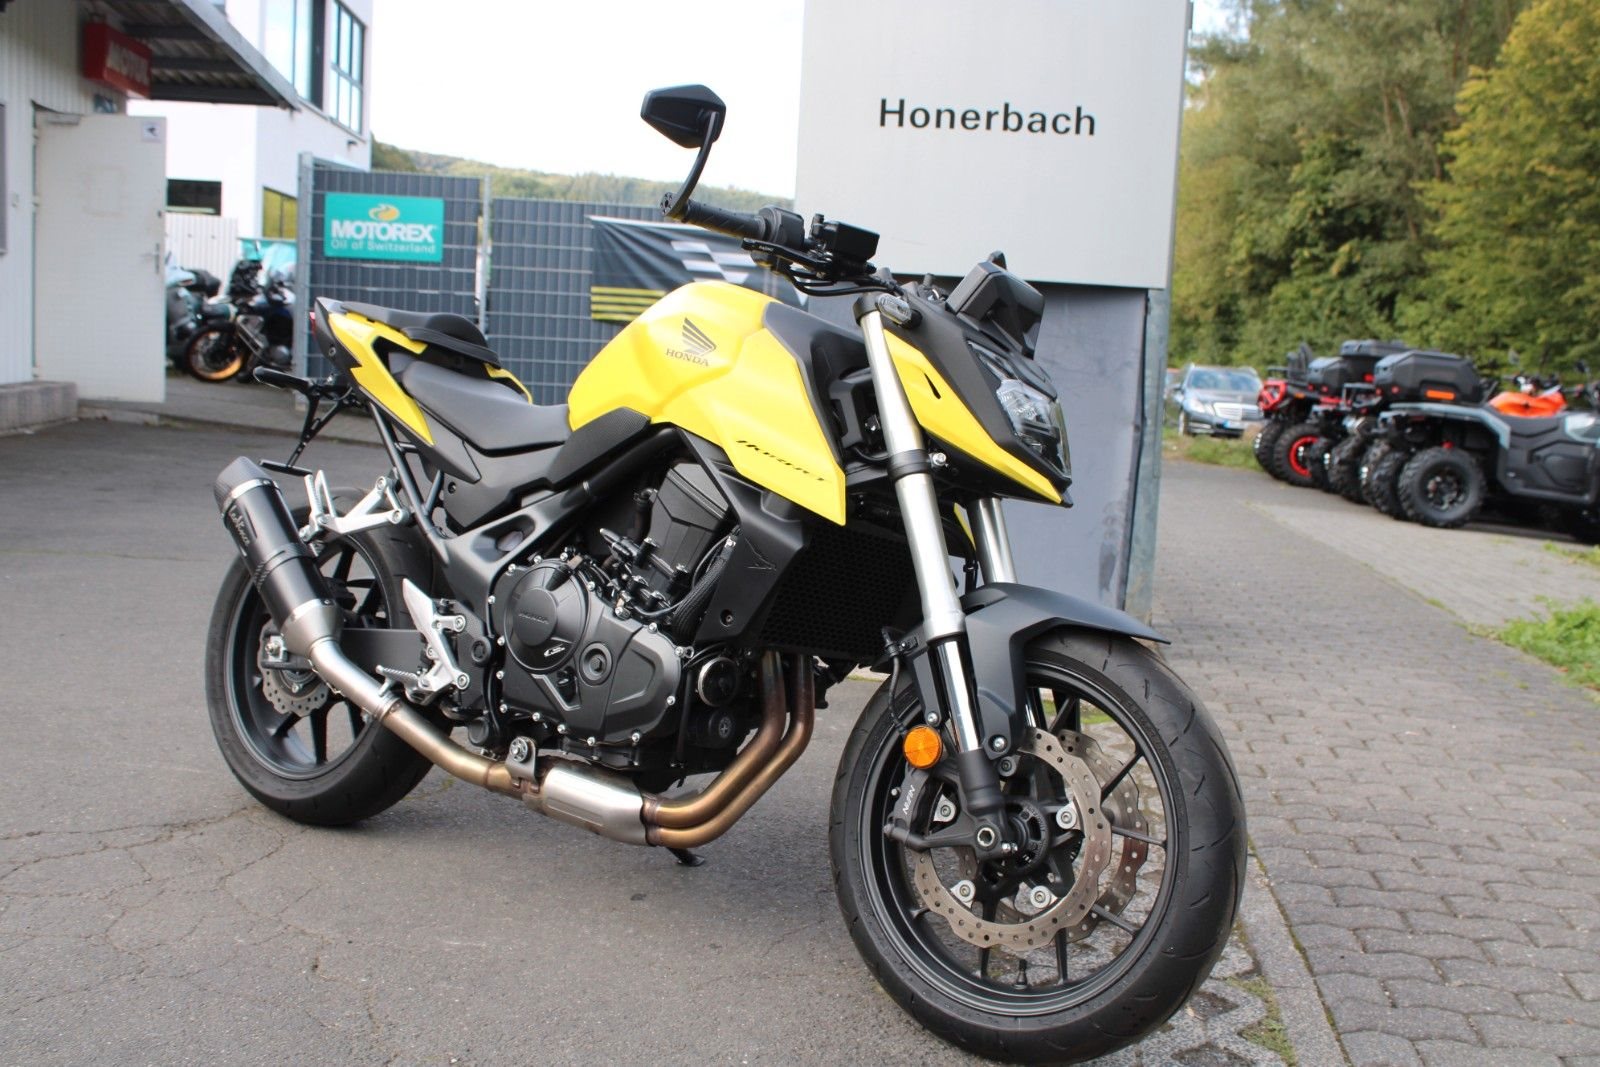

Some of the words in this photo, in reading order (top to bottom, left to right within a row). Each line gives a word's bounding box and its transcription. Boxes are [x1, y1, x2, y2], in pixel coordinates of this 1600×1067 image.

[880, 98, 1096, 137] Honerbach
[331, 219, 436, 243] MOTOREX
[331, 239, 347, 250] Oil
[351, 240, 364, 251] of
[367, 241, 436, 254] Switzerland
[665, 347, 710, 367] HONDA
